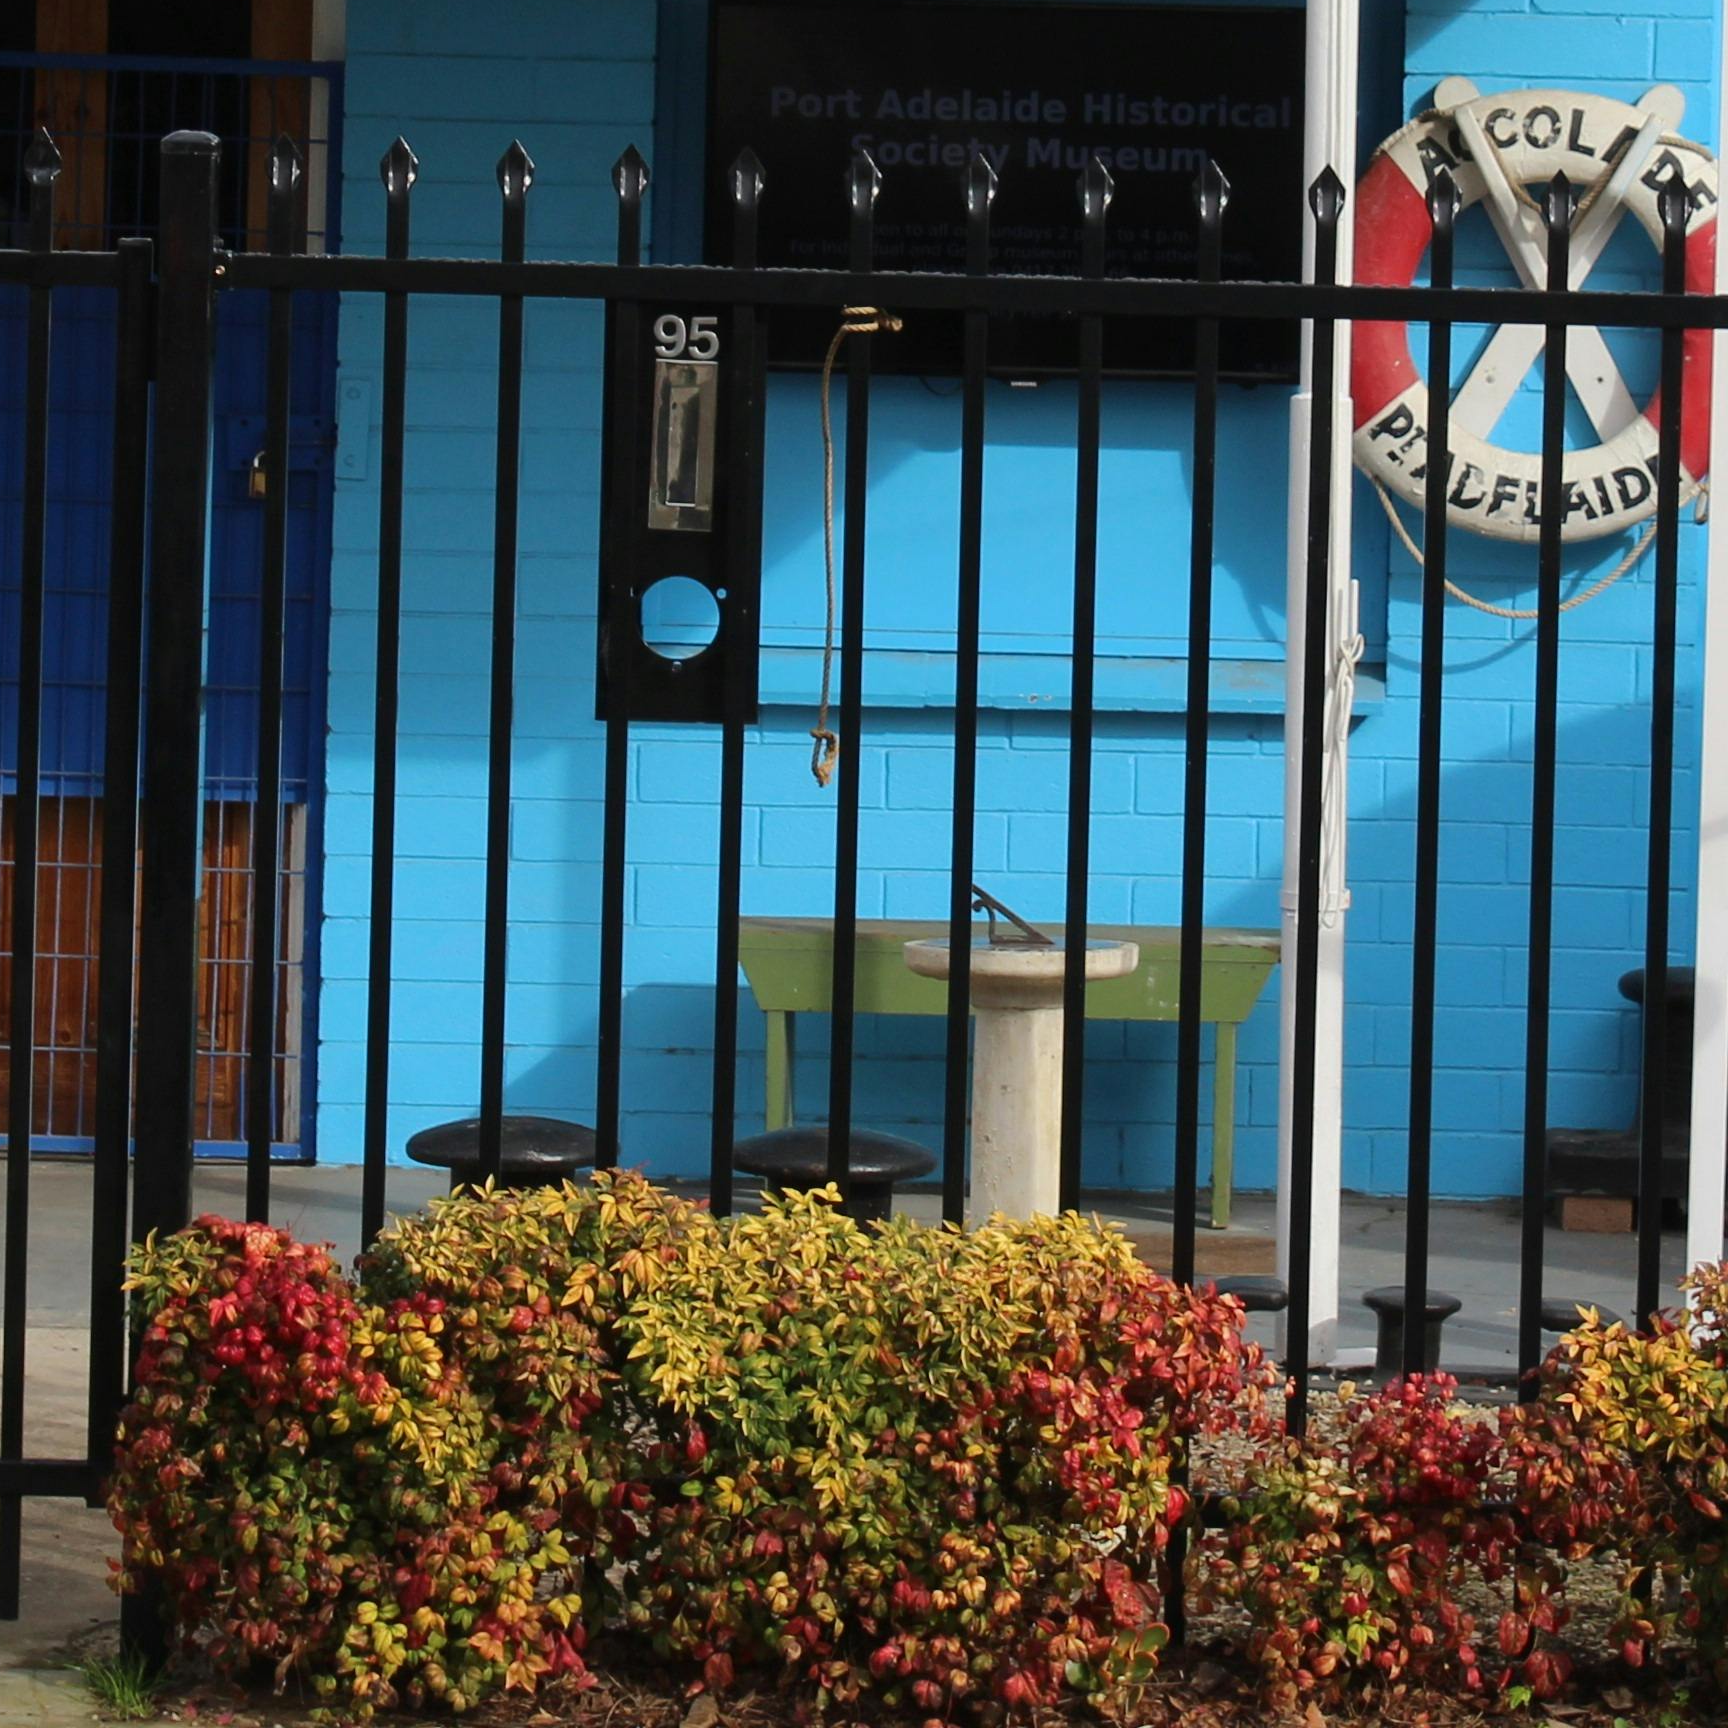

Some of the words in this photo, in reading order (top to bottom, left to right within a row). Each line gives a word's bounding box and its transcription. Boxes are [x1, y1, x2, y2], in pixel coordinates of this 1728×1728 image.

[770, 85, 863, 120] Port
[875, 88, 1068, 125] Adelaide
[1082, 93, 1293, 130] Historical
[850, 133, 1012, 173] Society
[1024, 137, 1210, 173] Museum
[653, 314, 720, 361] 95
[1408, 448, 1684, 525] DELAID
